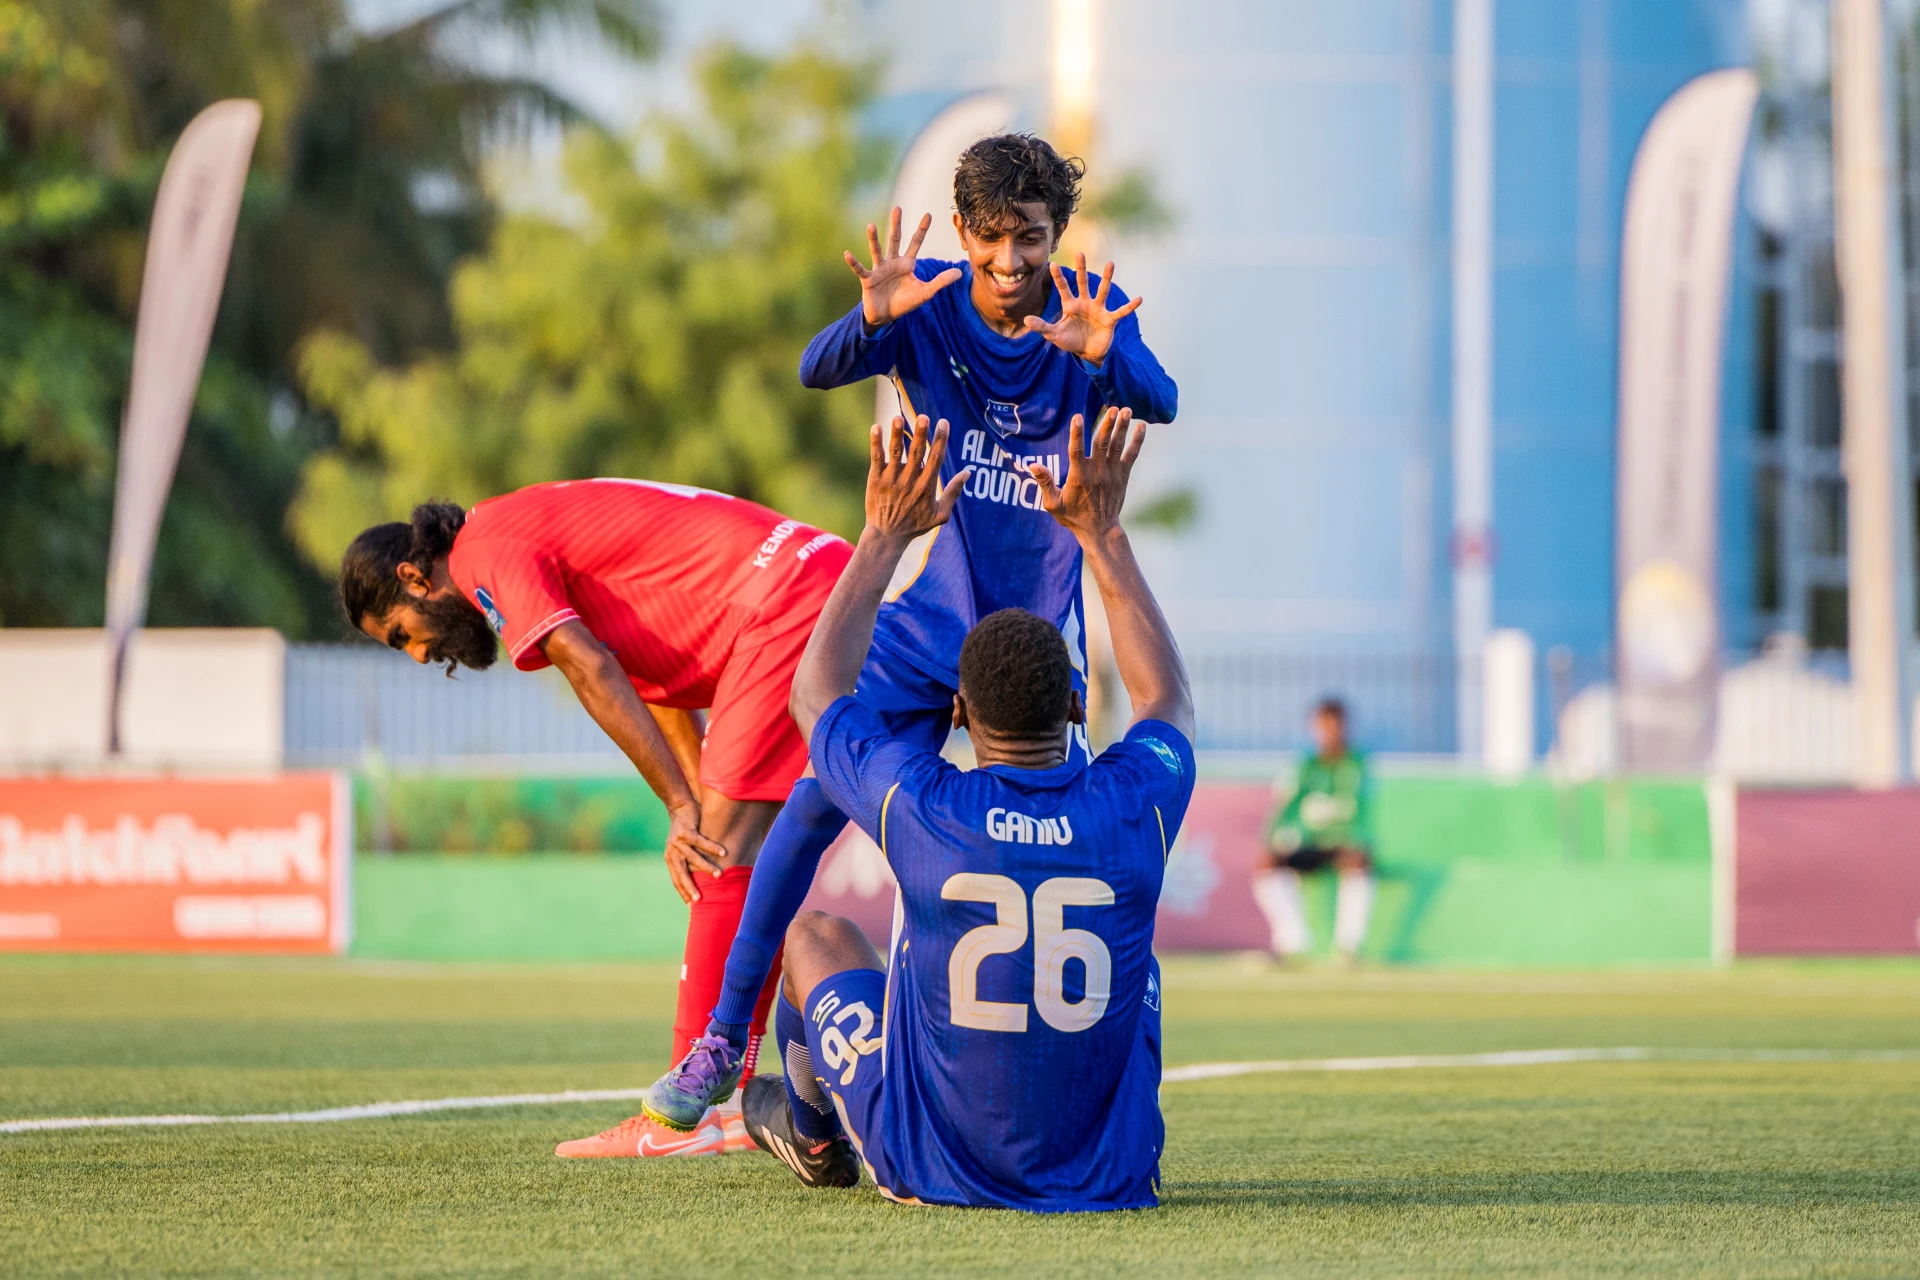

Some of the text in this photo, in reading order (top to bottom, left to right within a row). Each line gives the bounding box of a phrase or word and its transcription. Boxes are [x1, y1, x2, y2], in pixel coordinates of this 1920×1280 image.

[986, 807, 1073, 846] GANIU
[941, 872, 1116, 1033] 26
[820, 1000, 884, 1086] 92
